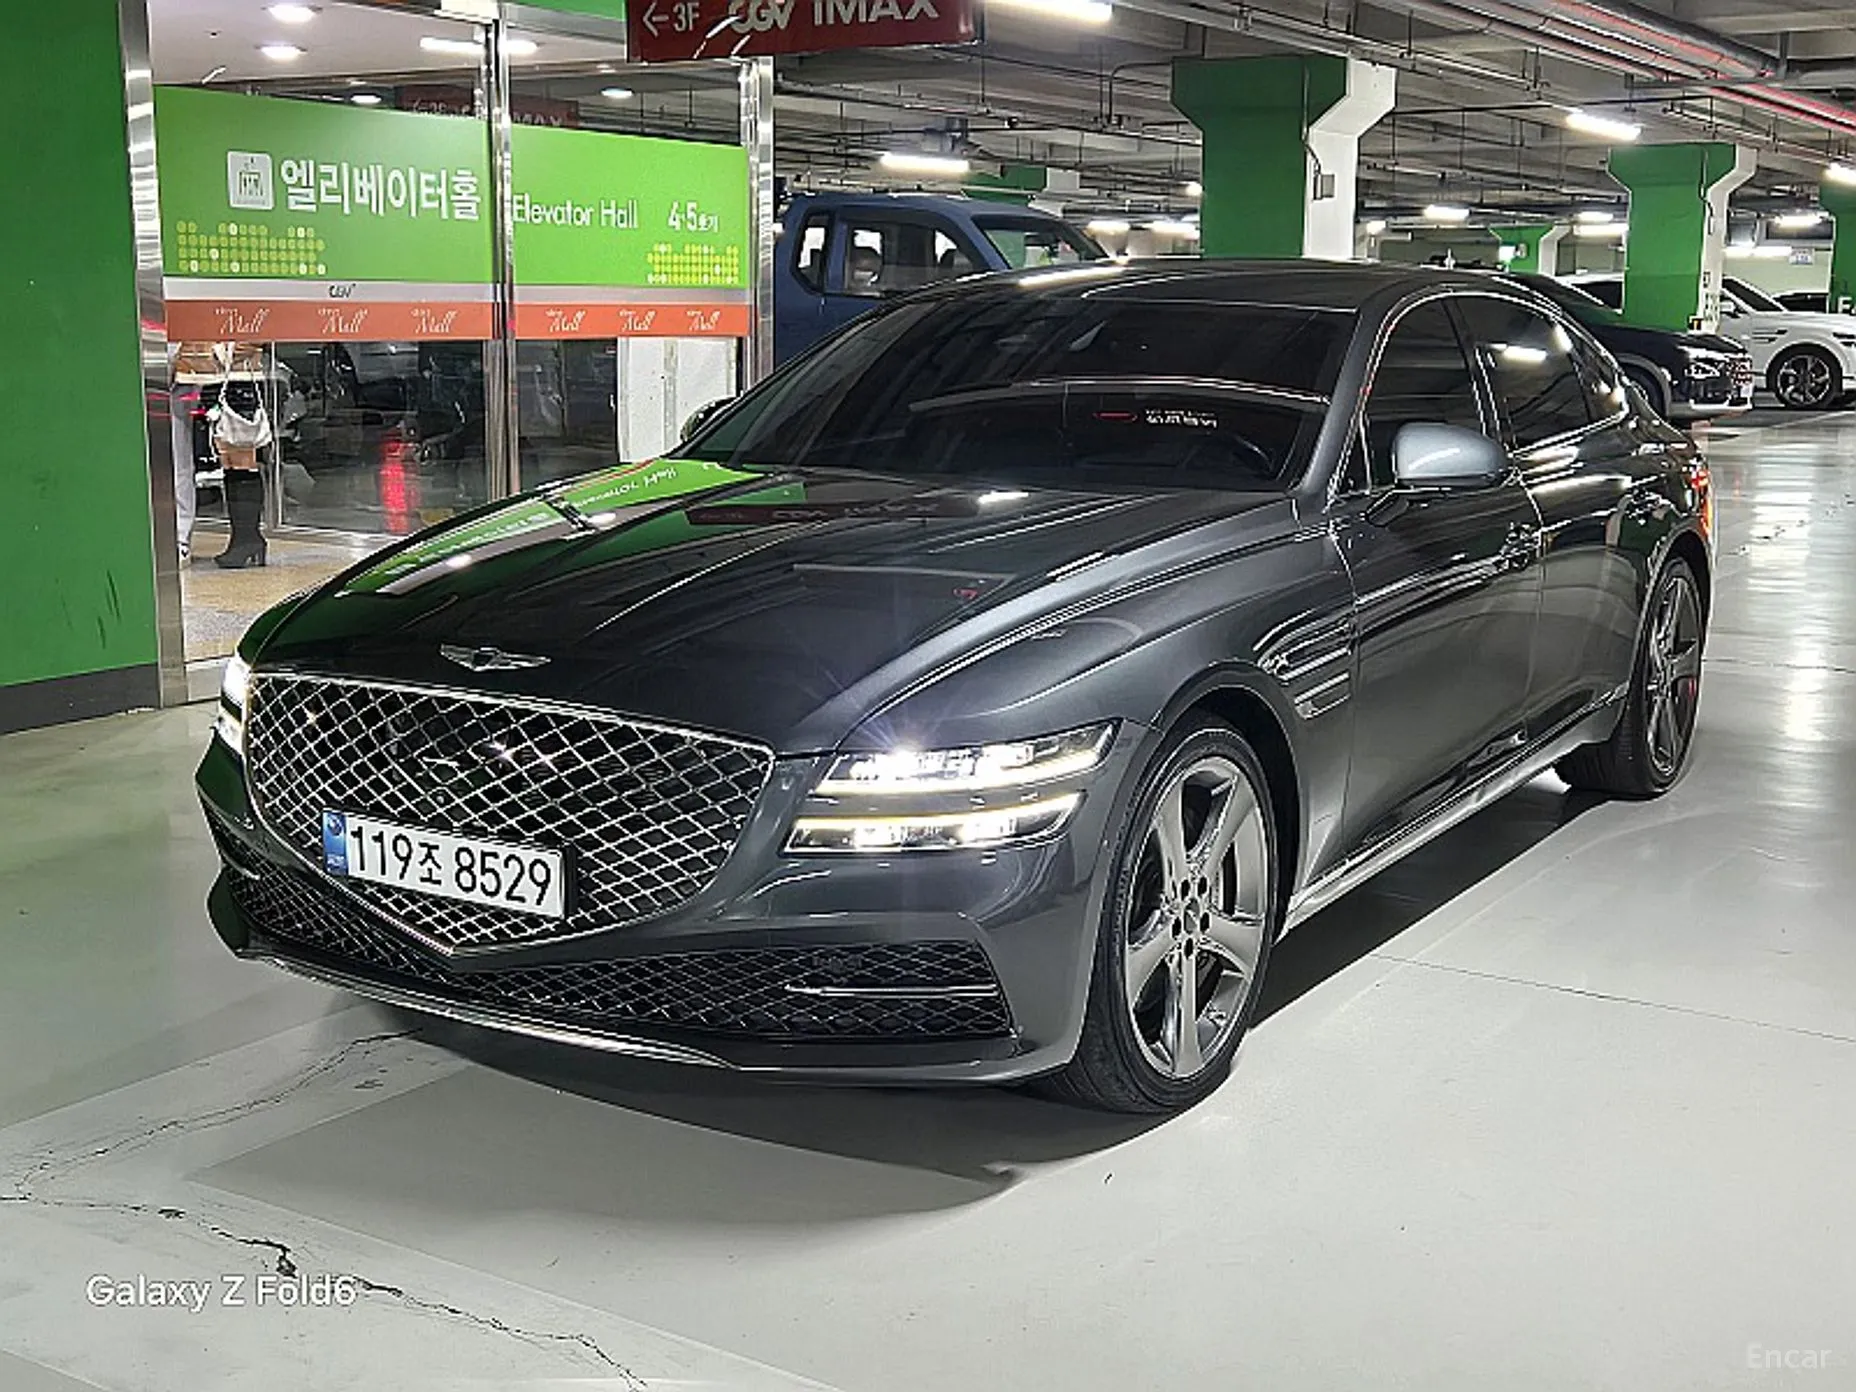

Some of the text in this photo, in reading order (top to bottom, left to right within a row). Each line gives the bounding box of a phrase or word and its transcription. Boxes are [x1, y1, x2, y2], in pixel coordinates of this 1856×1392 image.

[673, 0, 939, 34] 3F CGV IMAX
[281, 159, 481, 221] 엘리베이터홀
[513, 192, 638, 228] Elevator Hall
[351, 826, 552, 906] 119조 8529
